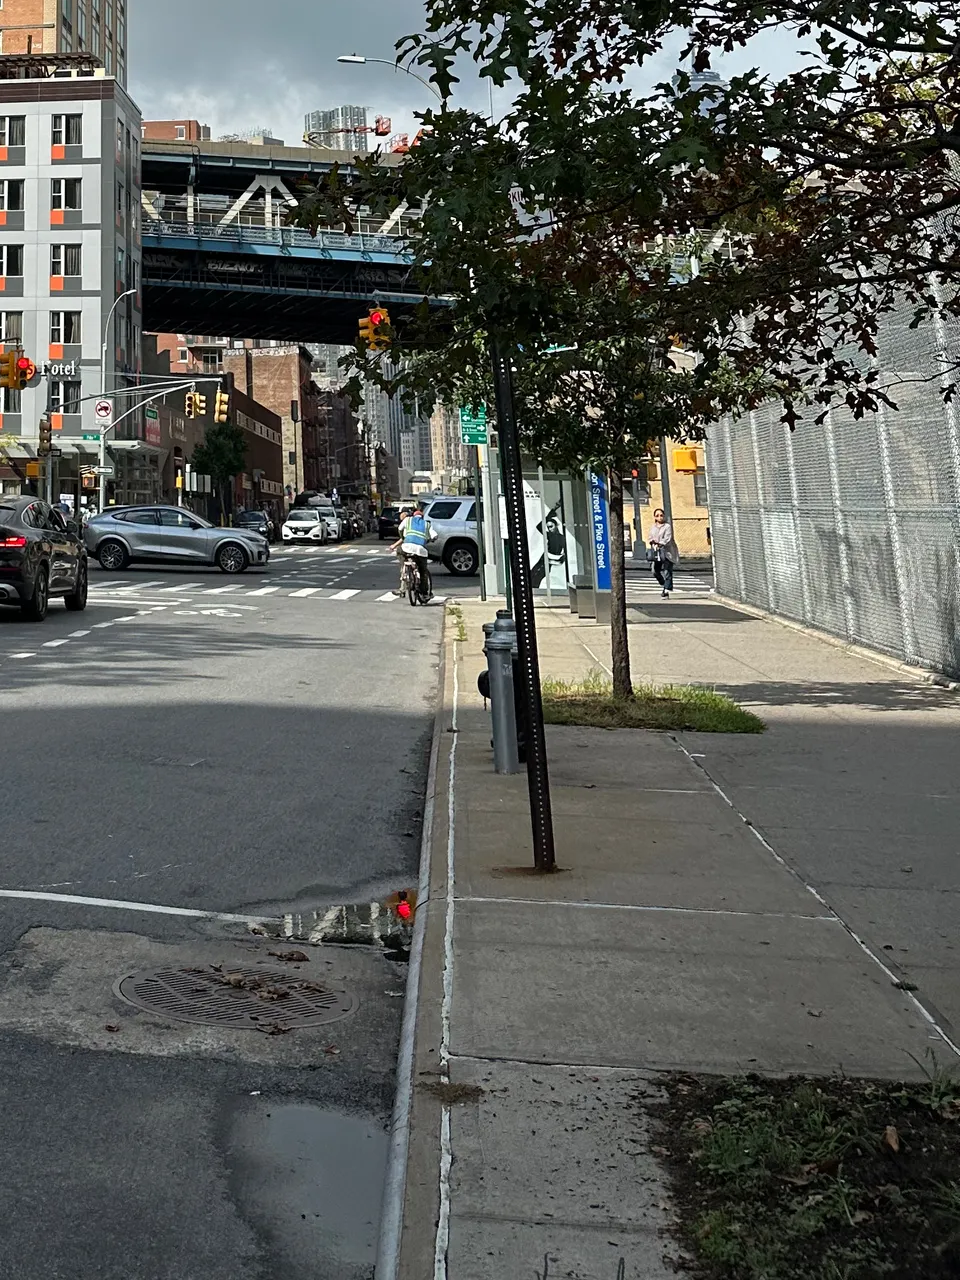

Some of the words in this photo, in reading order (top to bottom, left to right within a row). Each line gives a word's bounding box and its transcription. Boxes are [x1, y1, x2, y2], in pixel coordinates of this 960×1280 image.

[592, 487, 602, 513] Street
[594, 514, 603, 522] &
[595, 523, 604, 542] Pike
[596, 543, 606, 569] Street
